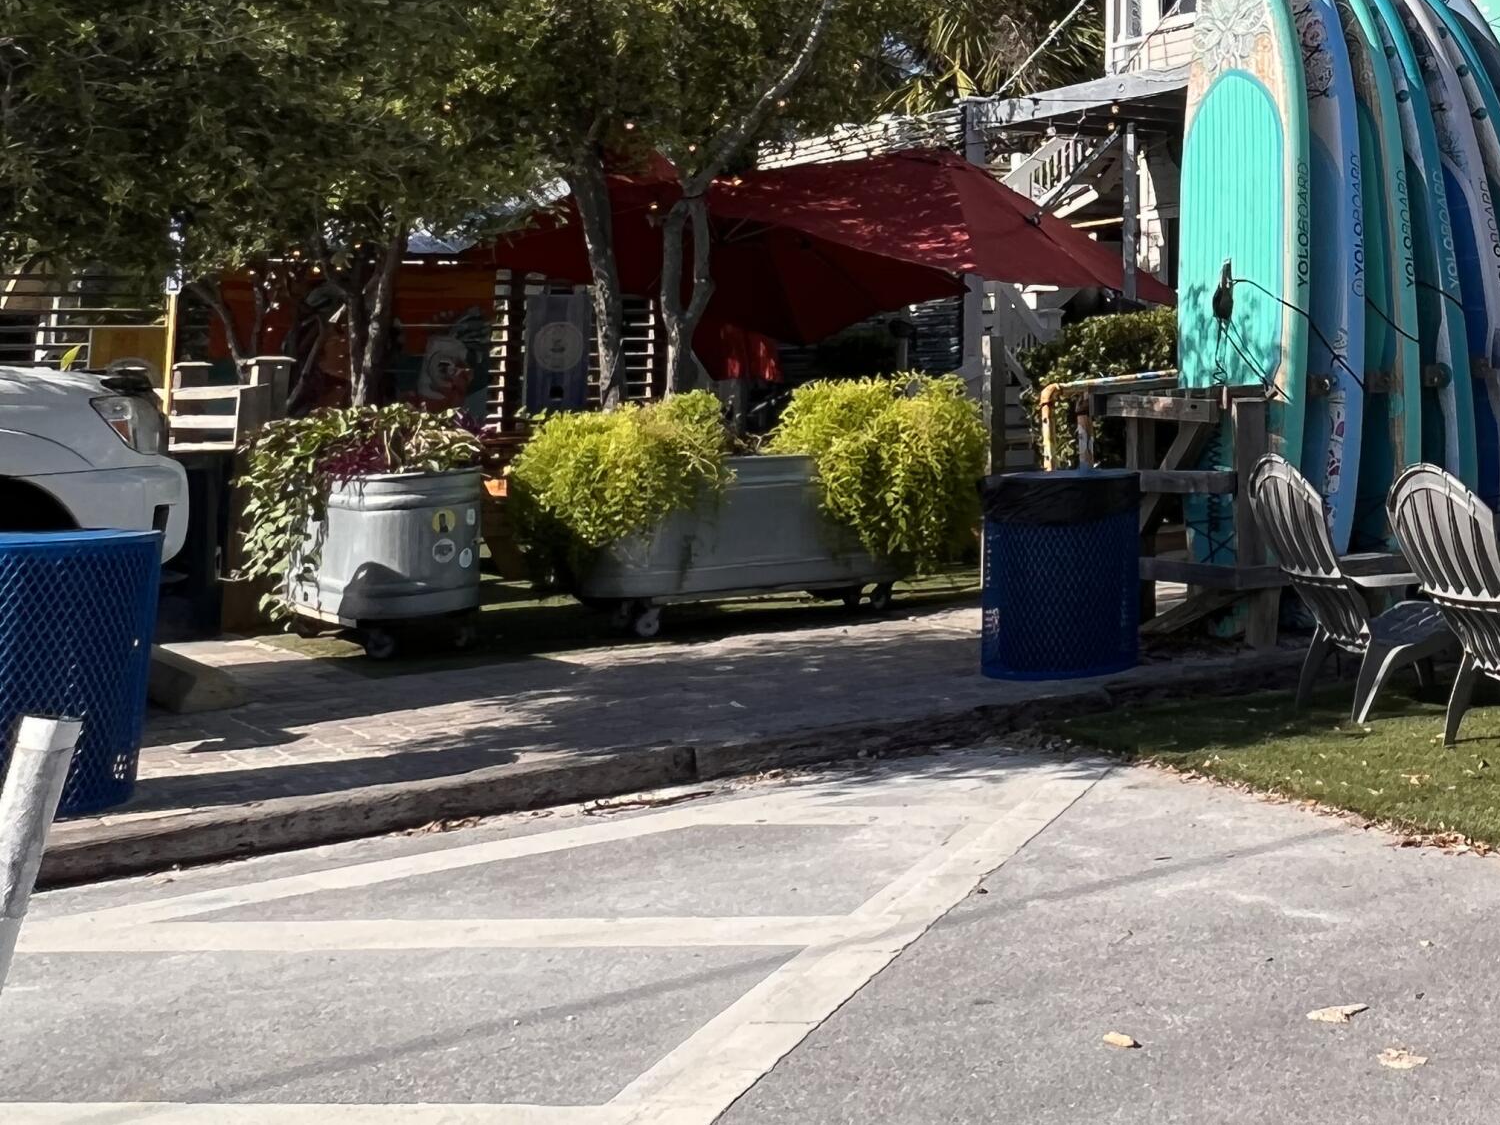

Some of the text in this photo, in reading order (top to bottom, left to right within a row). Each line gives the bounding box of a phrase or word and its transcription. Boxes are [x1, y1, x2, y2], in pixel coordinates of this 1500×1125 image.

[1297, 161, 1309, 288] YOLOBOARD
[1350, 153, 1364, 276] YOLOBOARD
[1432, 171, 1459, 289] YOLOBOARD
